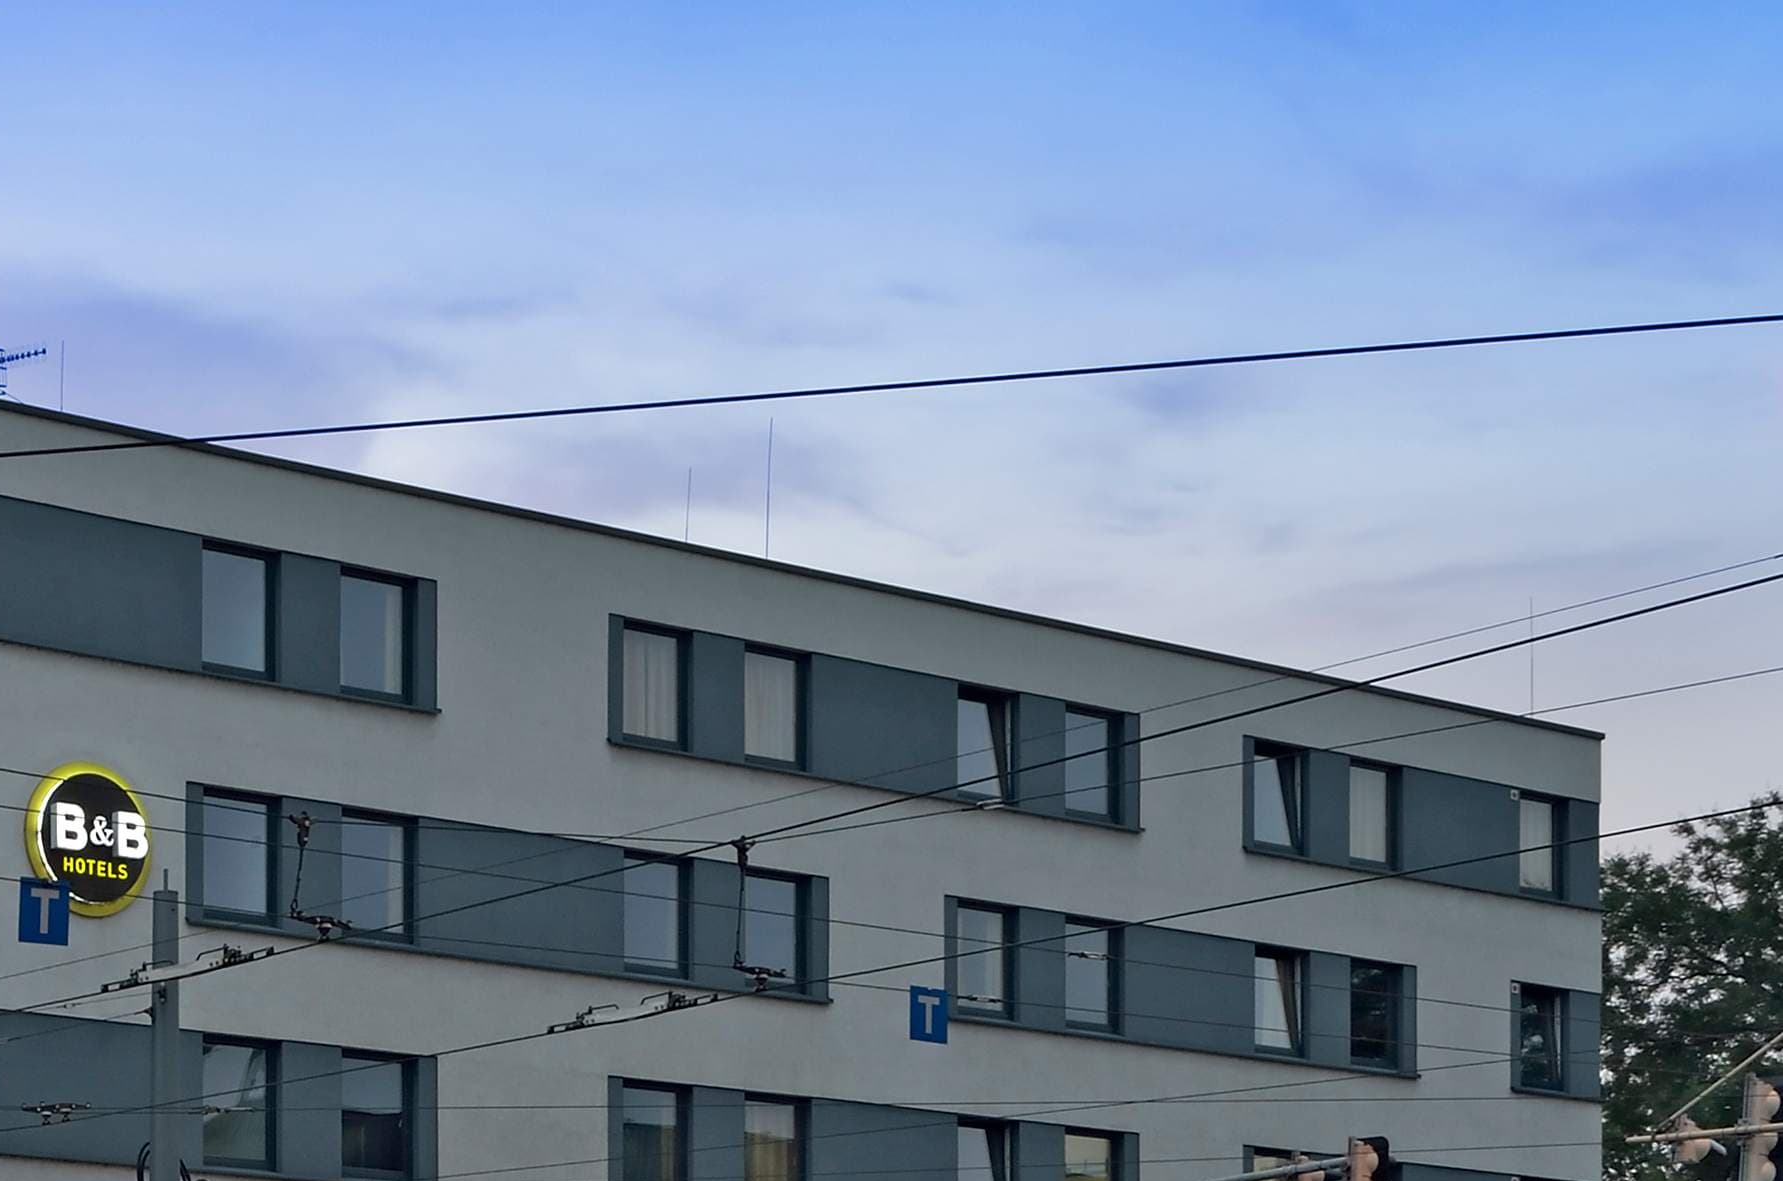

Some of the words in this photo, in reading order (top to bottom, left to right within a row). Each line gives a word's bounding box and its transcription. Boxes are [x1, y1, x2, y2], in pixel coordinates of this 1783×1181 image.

[53, 801, 149, 860] B&B
[63, 856, 128, 880] HOTELS
[20, 888, 60, 934] T
[918, 995, 940, 1034] T
